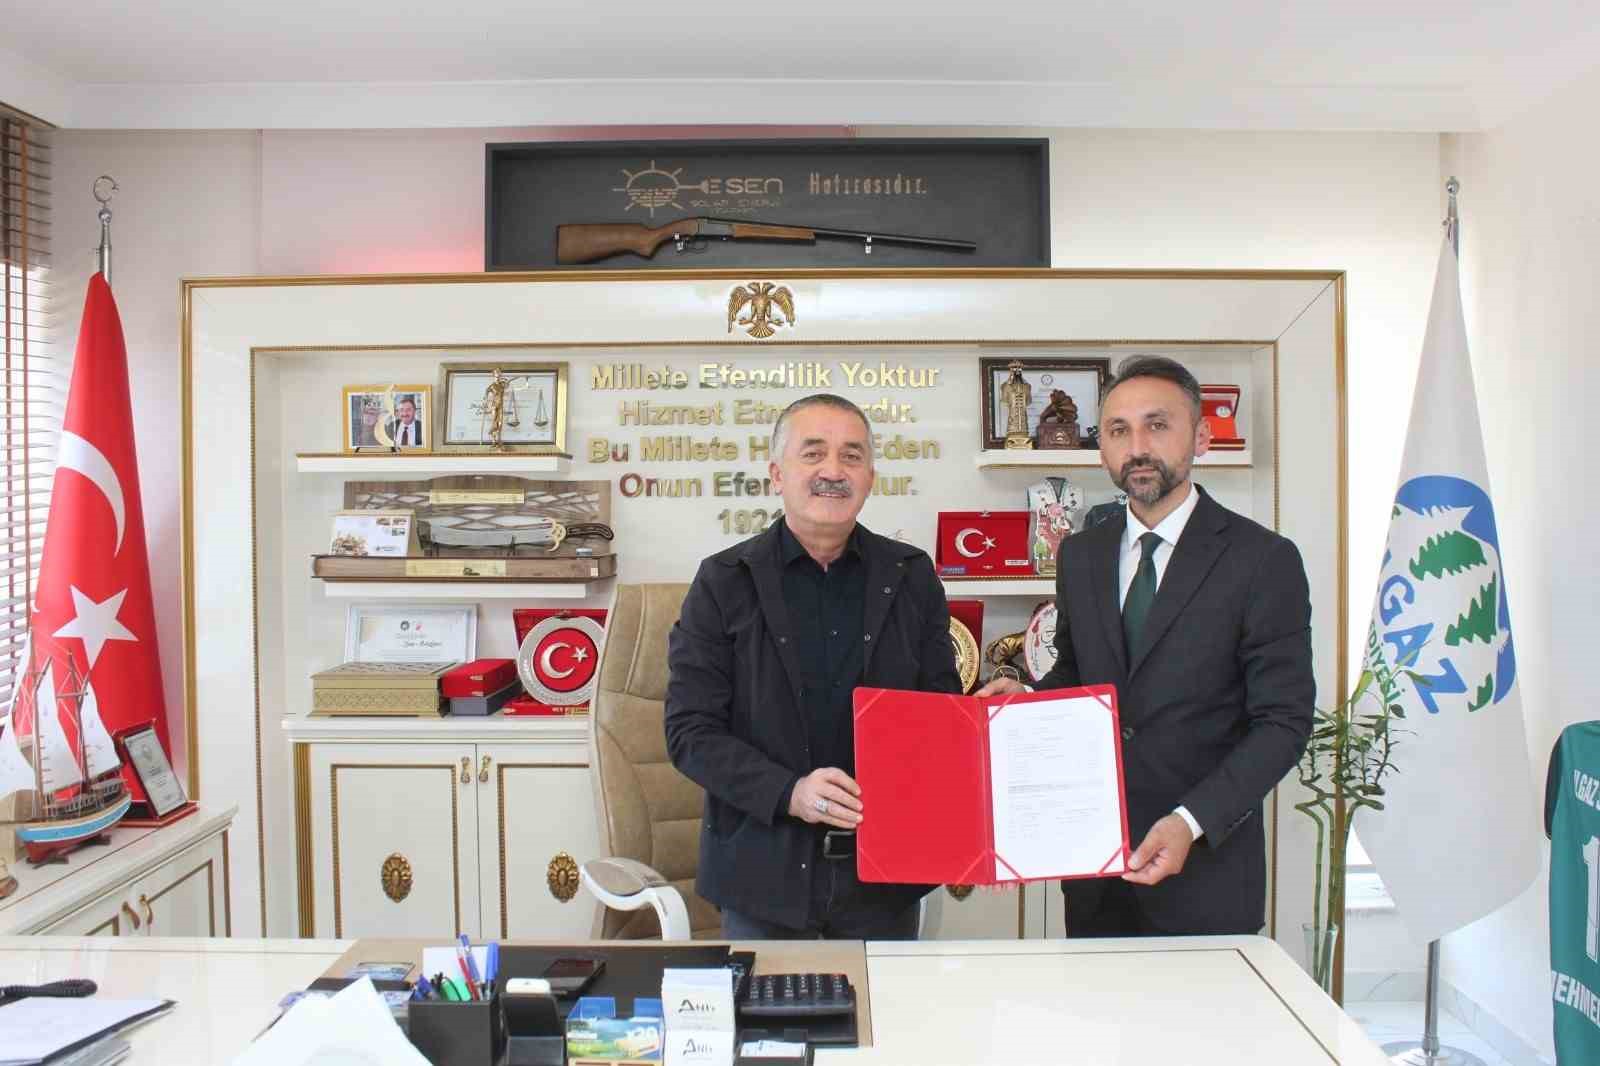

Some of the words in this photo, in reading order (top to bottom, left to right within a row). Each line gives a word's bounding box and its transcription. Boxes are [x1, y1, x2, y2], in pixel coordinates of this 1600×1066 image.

[591, 362, 689, 391] Millete
[699, 361, 832, 390] Efendilik
[840, 362, 940, 388] Yoktur
[619, 399, 724, 426] Hizmet
[589, 437, 630, 463] Bu
[640, 436, 738, 462] Millete
[872, 433, 941, 460] Eden
[619, 472, 702, 498] Onun
[1380, 549, 1468, 714] GAZ
